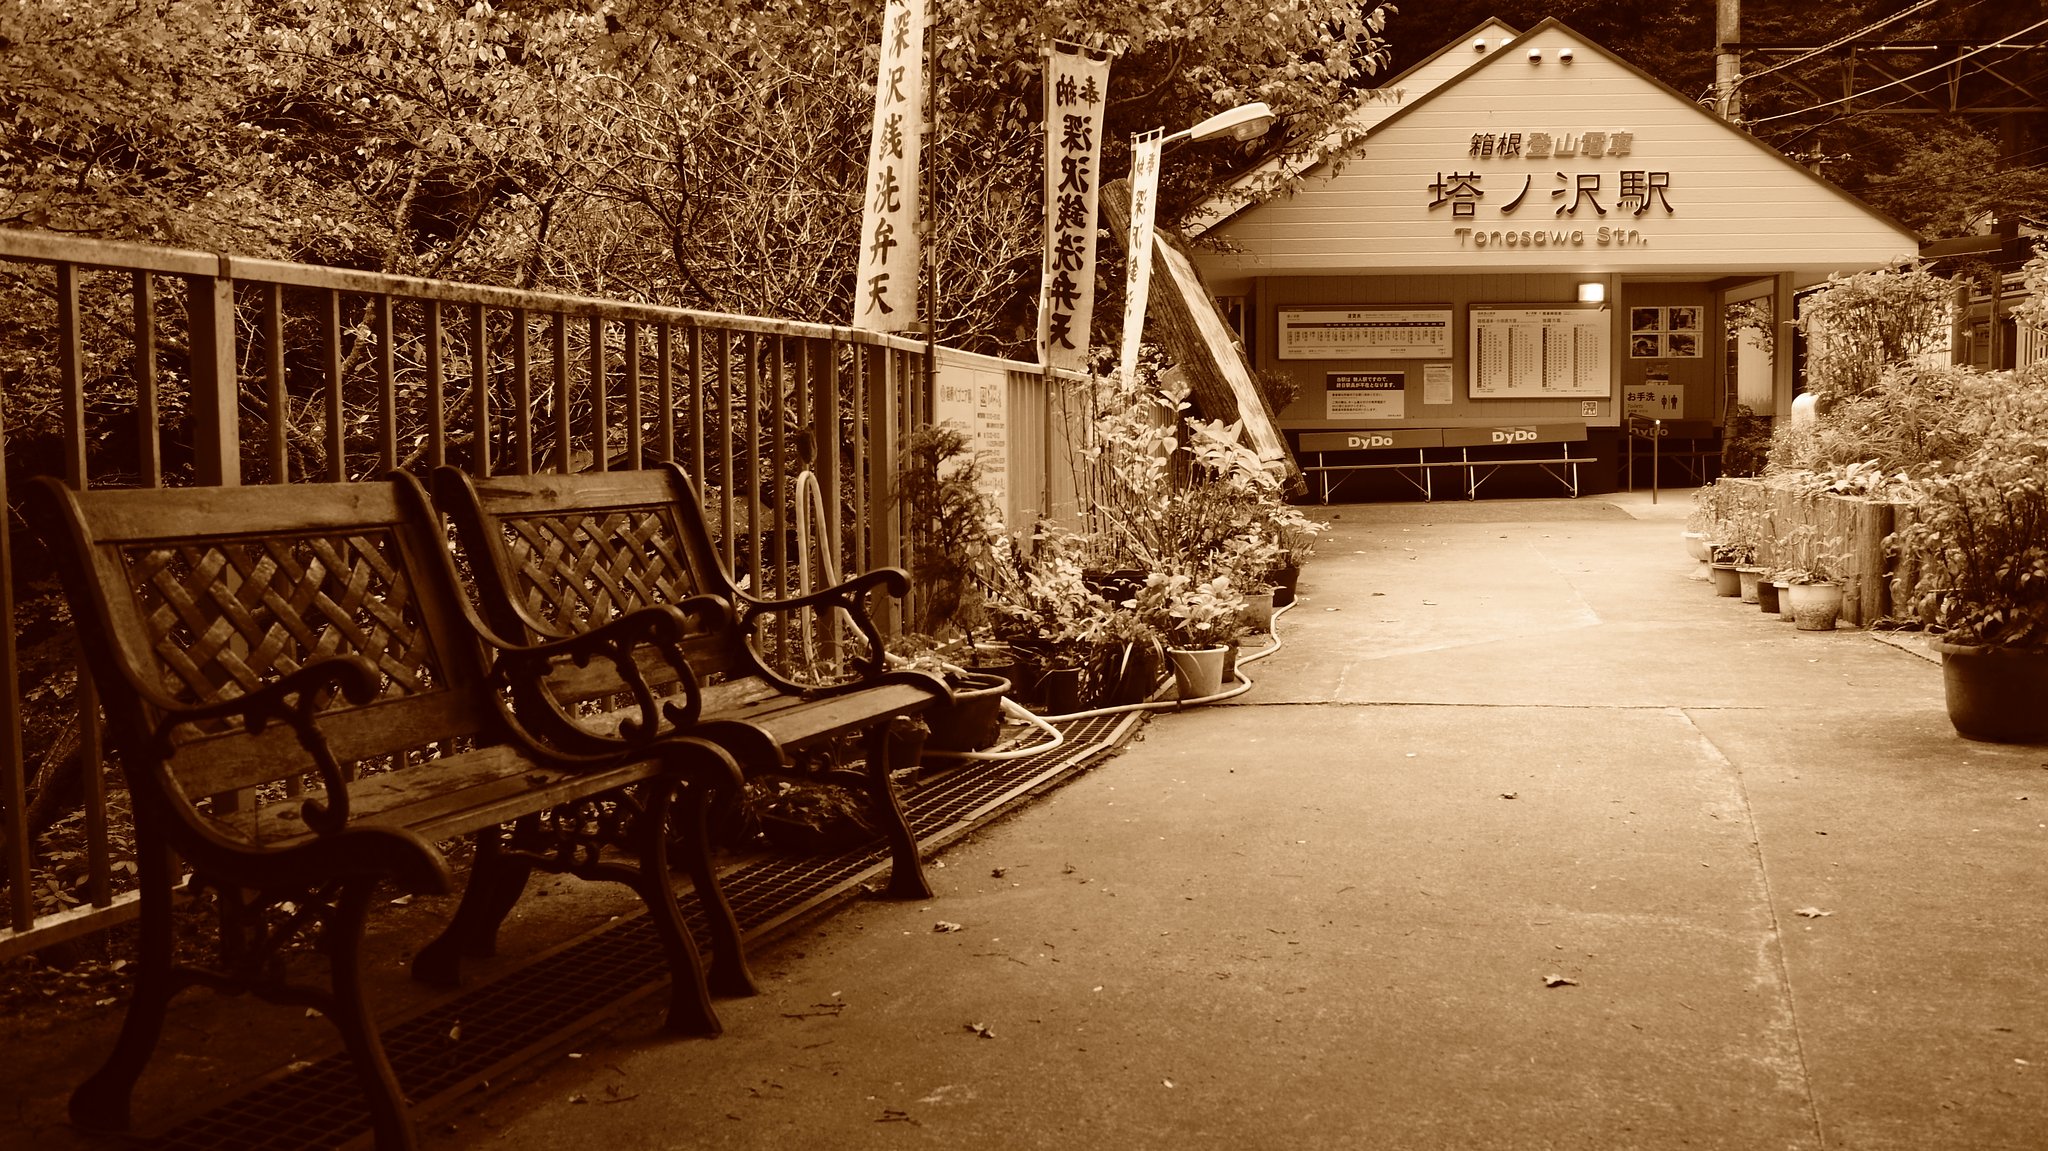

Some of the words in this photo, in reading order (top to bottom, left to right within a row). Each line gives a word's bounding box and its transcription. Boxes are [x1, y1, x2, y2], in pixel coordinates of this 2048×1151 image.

[1469, 131, 1634, 158] 箱根登山電車
[1428, 171, 1674, 218] 塔ノ沢駅
[1454, 227, 1584, 246] Tonosawa
[1596, 226, 1648, 246] Stn.
[1627, 392, 1655, 402] お手洗
[1348, 436, 1393, 449] DyDo
[1492, 430, 1537, 444] DyDo
